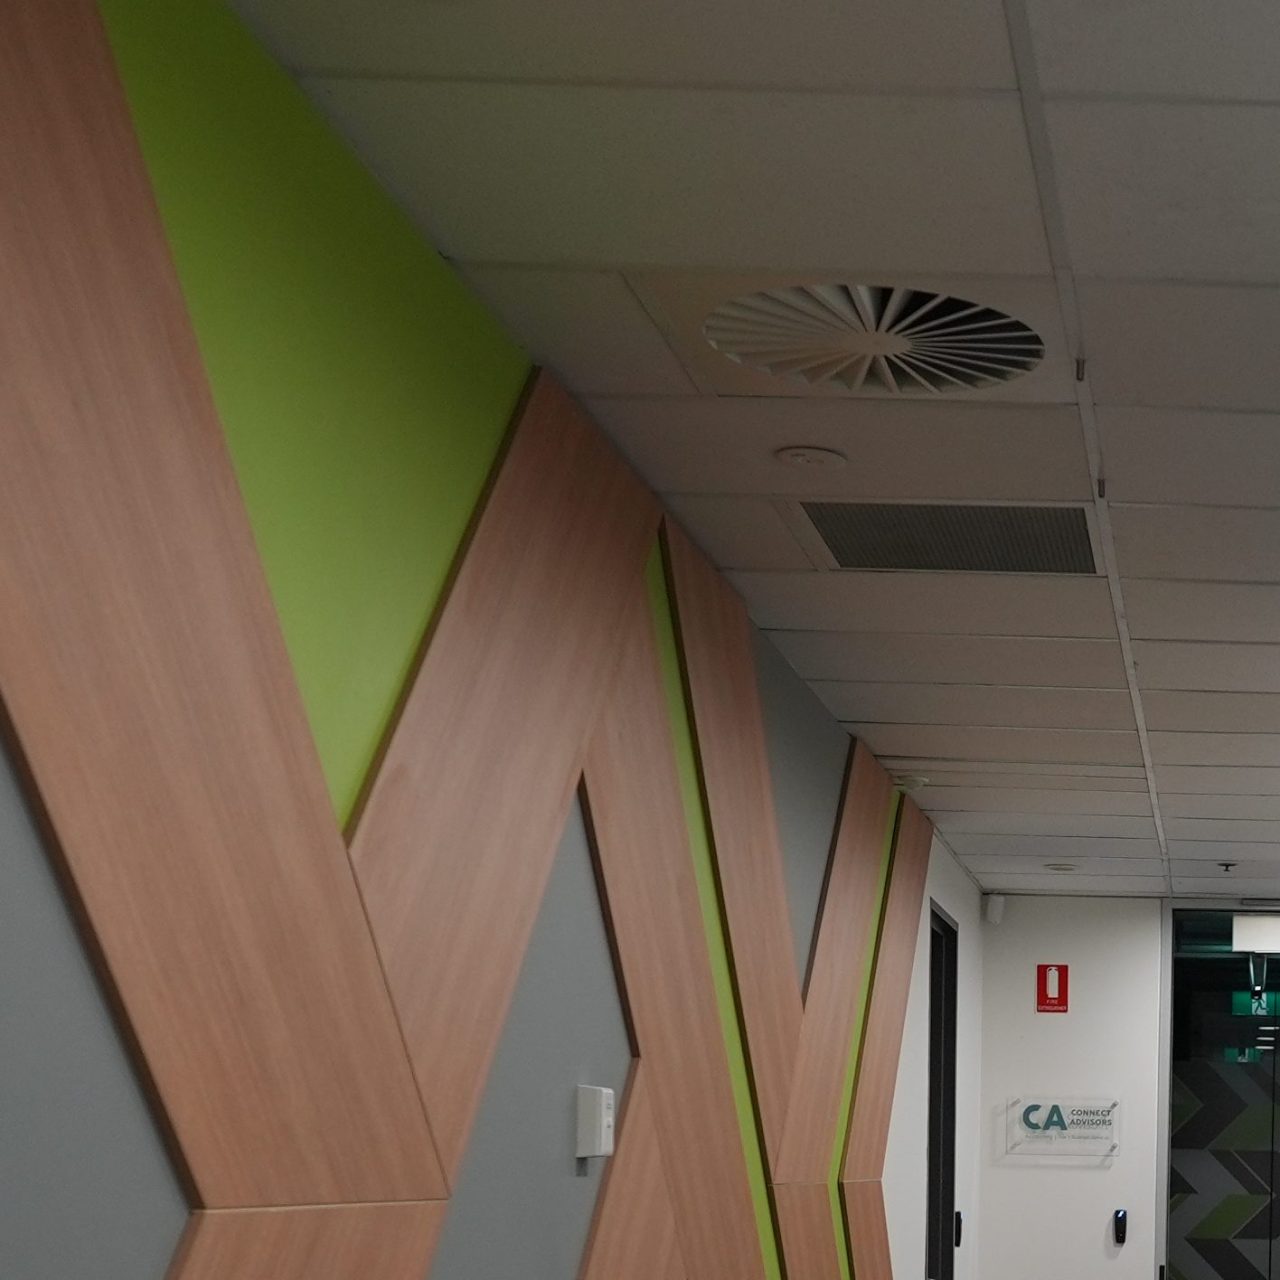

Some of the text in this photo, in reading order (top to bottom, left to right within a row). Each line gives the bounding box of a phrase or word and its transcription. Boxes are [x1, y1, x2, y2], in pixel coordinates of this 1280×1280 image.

[1070, 1108, 1112, 1117] CONNECT
[1022, 1104, 1068, 1131] CA
[1069, 1118, 1113, 1127] ADVISORS
